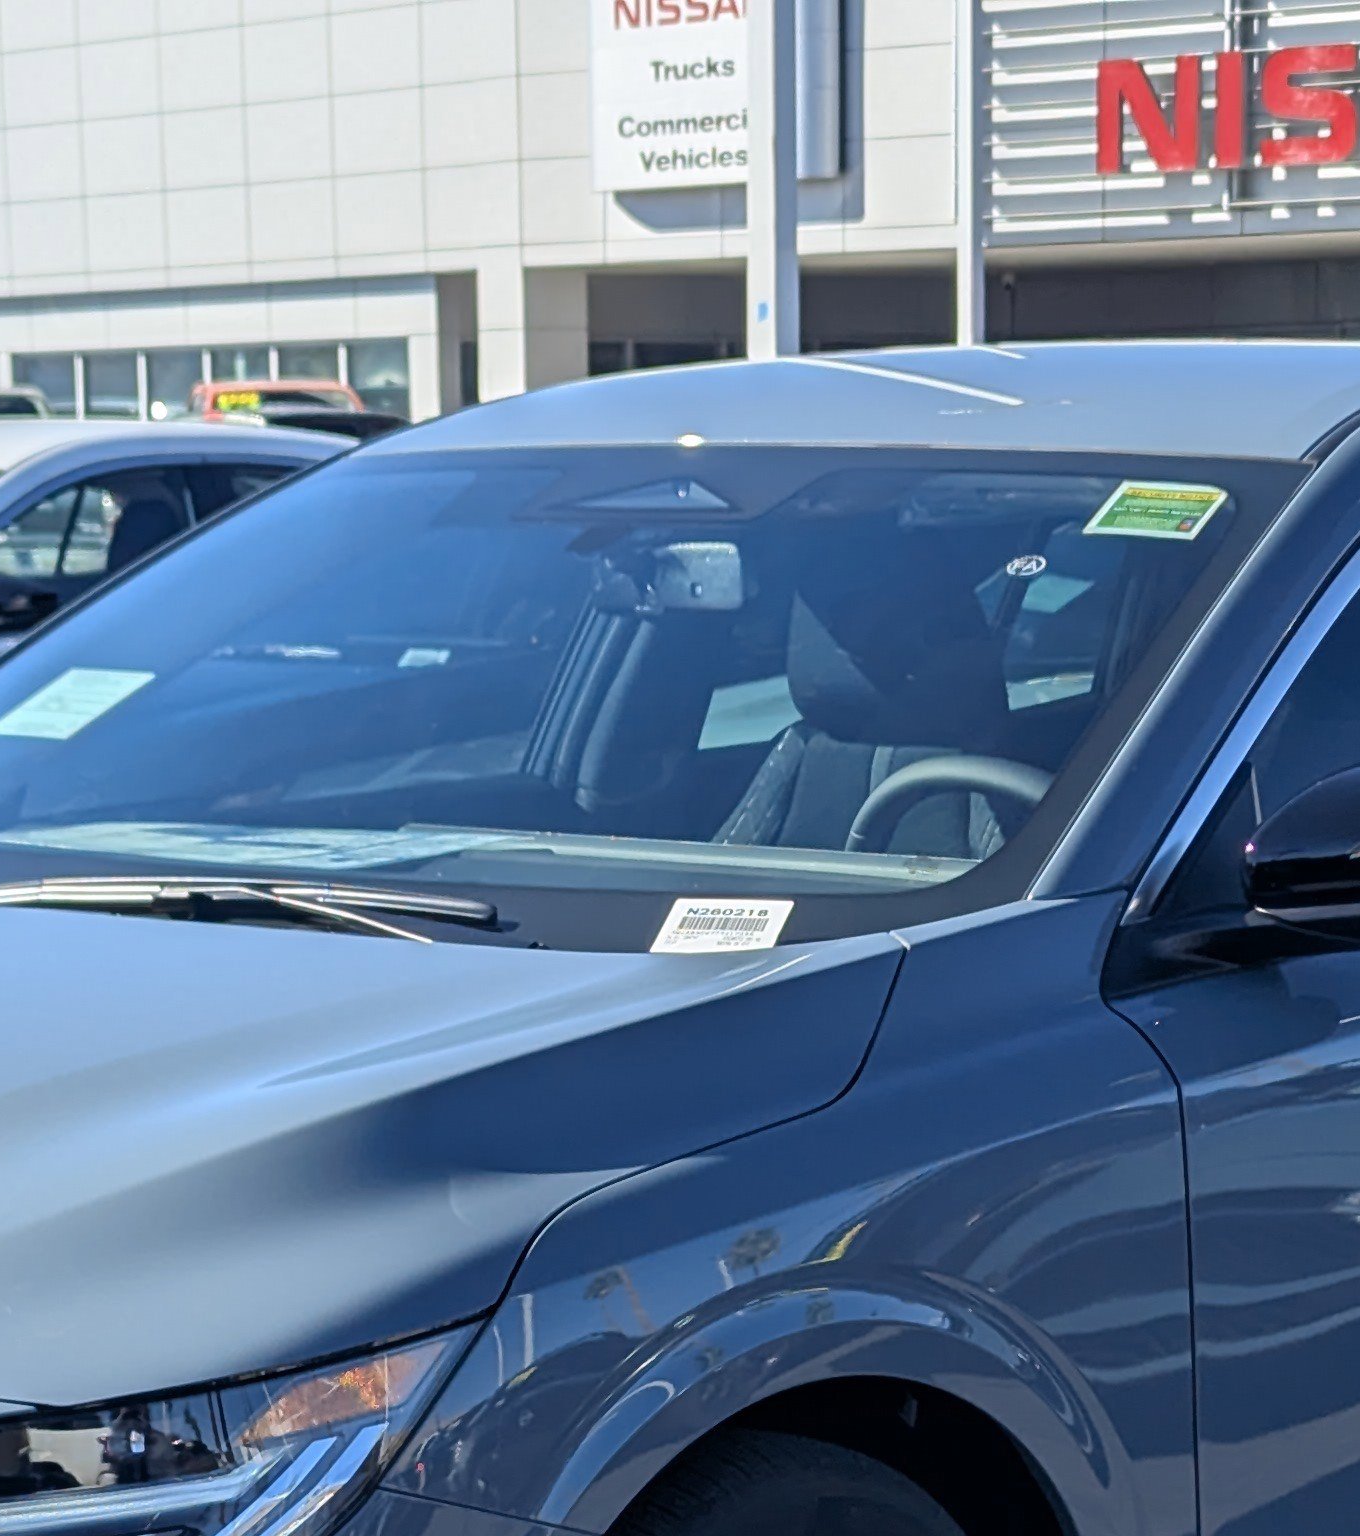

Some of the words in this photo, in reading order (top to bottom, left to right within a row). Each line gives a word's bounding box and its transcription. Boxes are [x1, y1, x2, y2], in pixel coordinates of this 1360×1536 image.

[613, 0, 747, 31] NISSA
[649, 56, 736, 83] Trucks
[617, 107, 748, 139] Commerci
[639, 147, 748, 173] Vehicles
